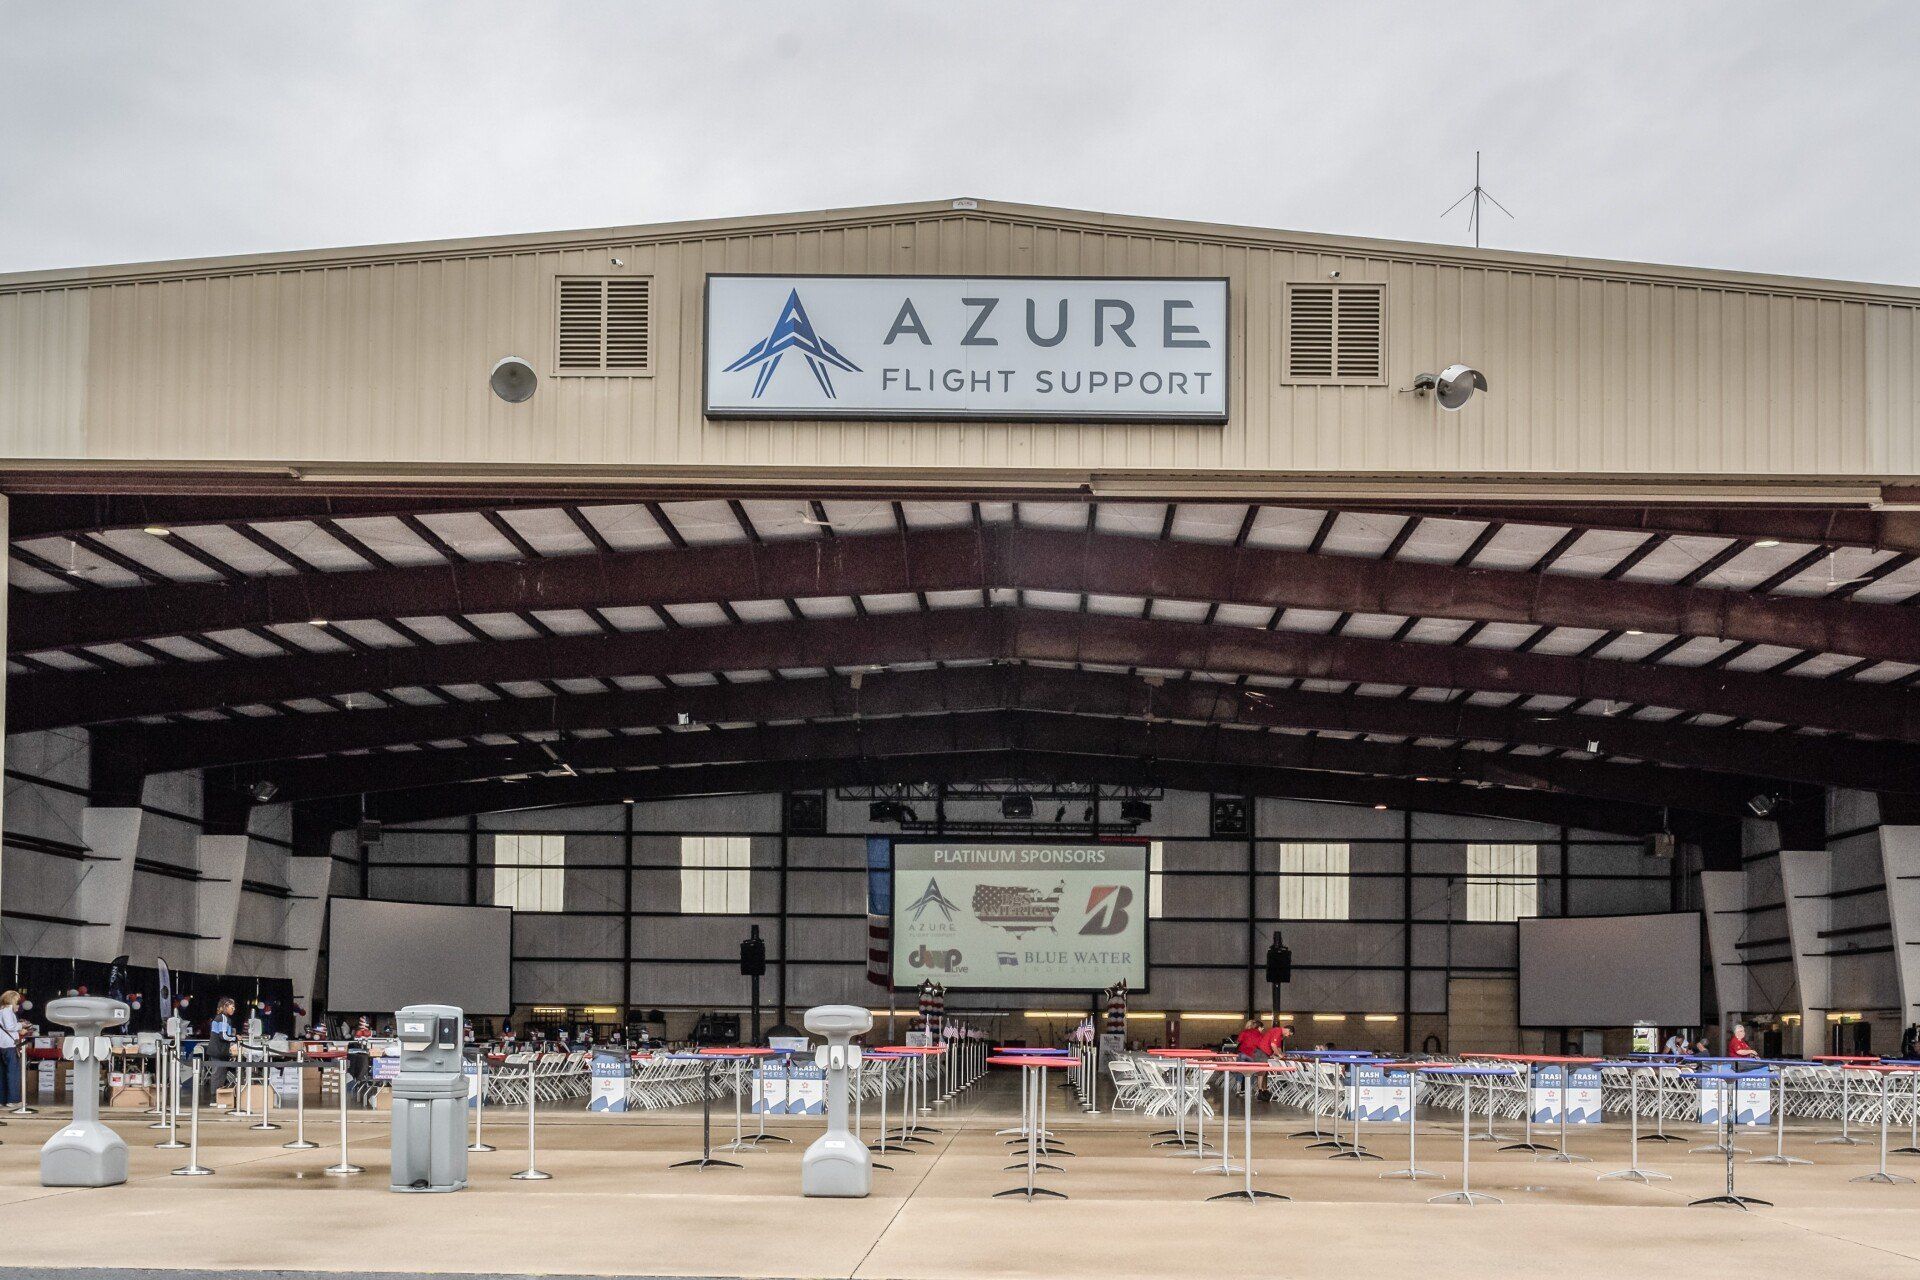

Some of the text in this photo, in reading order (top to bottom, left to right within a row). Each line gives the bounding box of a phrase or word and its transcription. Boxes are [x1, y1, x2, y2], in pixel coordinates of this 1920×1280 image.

[883, 297, 1212, 348] AZURE
[882, 368, 1213, 395] FLIGHT SUPPORT
[934, 849, 1106, 864] PLATINUM SPONSORS
[908, 923, 957, 931] AZURE
[1025, 951, 1132, 964] BLUE WATER
